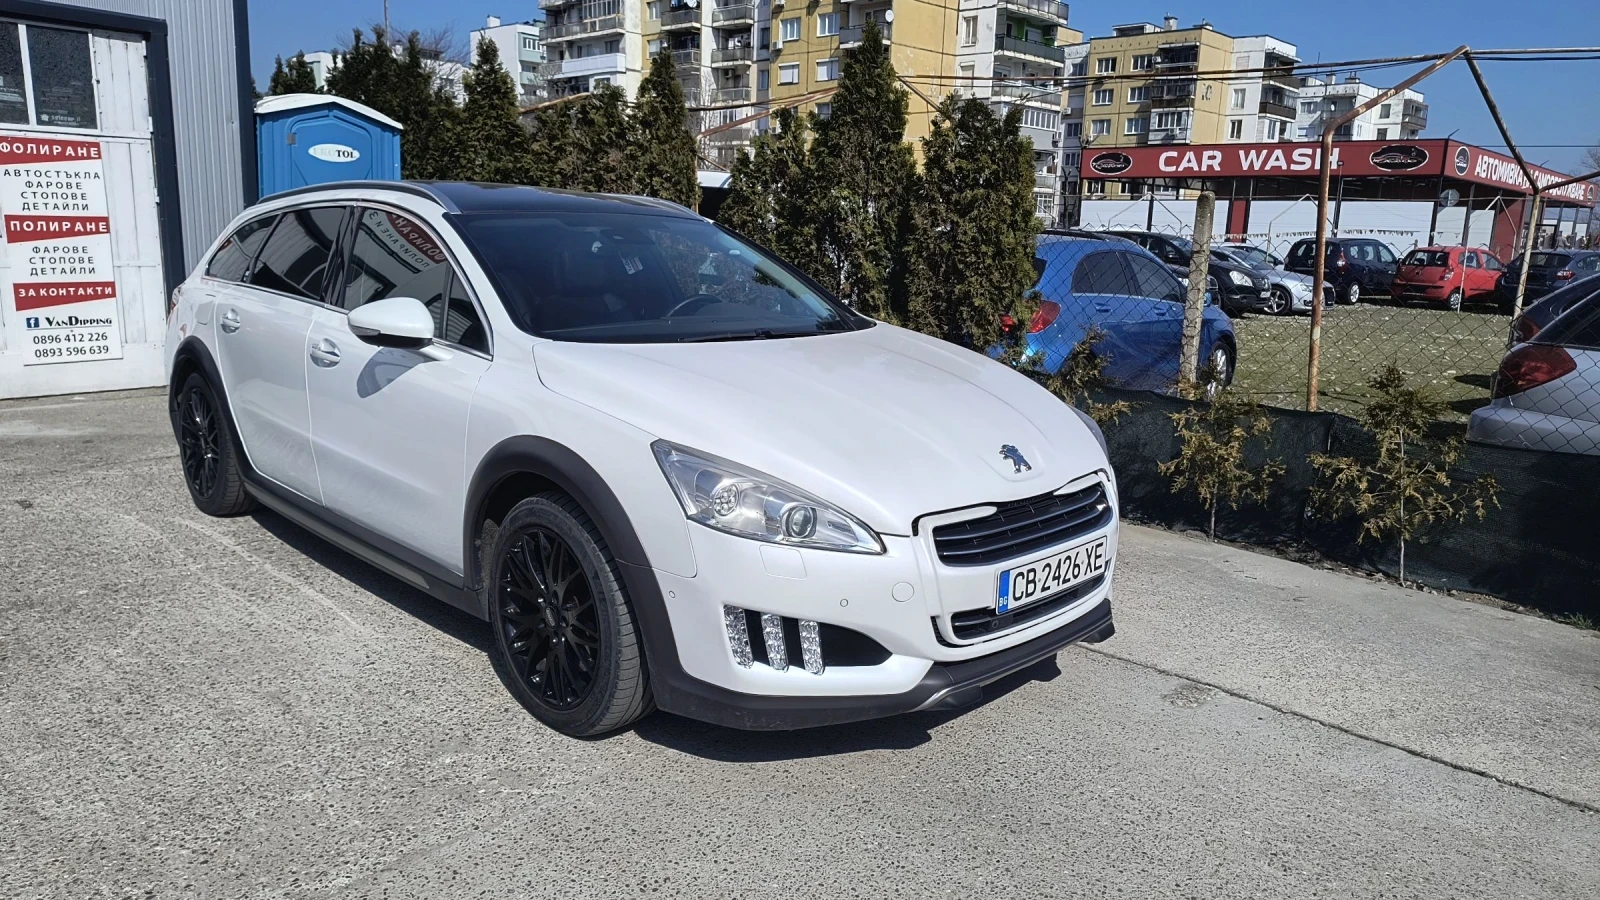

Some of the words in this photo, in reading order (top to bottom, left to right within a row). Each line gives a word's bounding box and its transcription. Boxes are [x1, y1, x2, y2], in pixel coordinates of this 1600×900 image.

[0, 141, 100, 158] ФОЛИРАНЕ
[1158, 150, 1223, 172] CAR
[1238, 147, 1341, 171] WASH
[3, 168, 101, 180] АВТОСТЪКЛА
[24, 180, 83, 190] ФАРОВЕ
[20, 191, 88, 201] СТОПОВЕ
[22, 202, 90, 212] ДЕТАЙЛИ
[10, 220, 108, 232] ПОЛИРАНЕ
[32, 245, 89, 254] ФАРОВЕ
[29, 256, 95, 265] СТОПОВЕ
[29, 266, 96, 277] ДЕТАЙЛИ
[18, 288, 36, 298] ЗА
[39, 286, 113, 297] КОНТАКТИ
[33, 334, 62, 345] 0896
[64, 333, 85, 343] 412
[87, 332, 108, 341] 226
[34, 347, 63, 358] 0893
[66, 346, 87, 357] 596
[89, 344, 109, 354] 639
[1040, 551, 1081, 593] 2426
[998, 596, 1008, 607] BG
